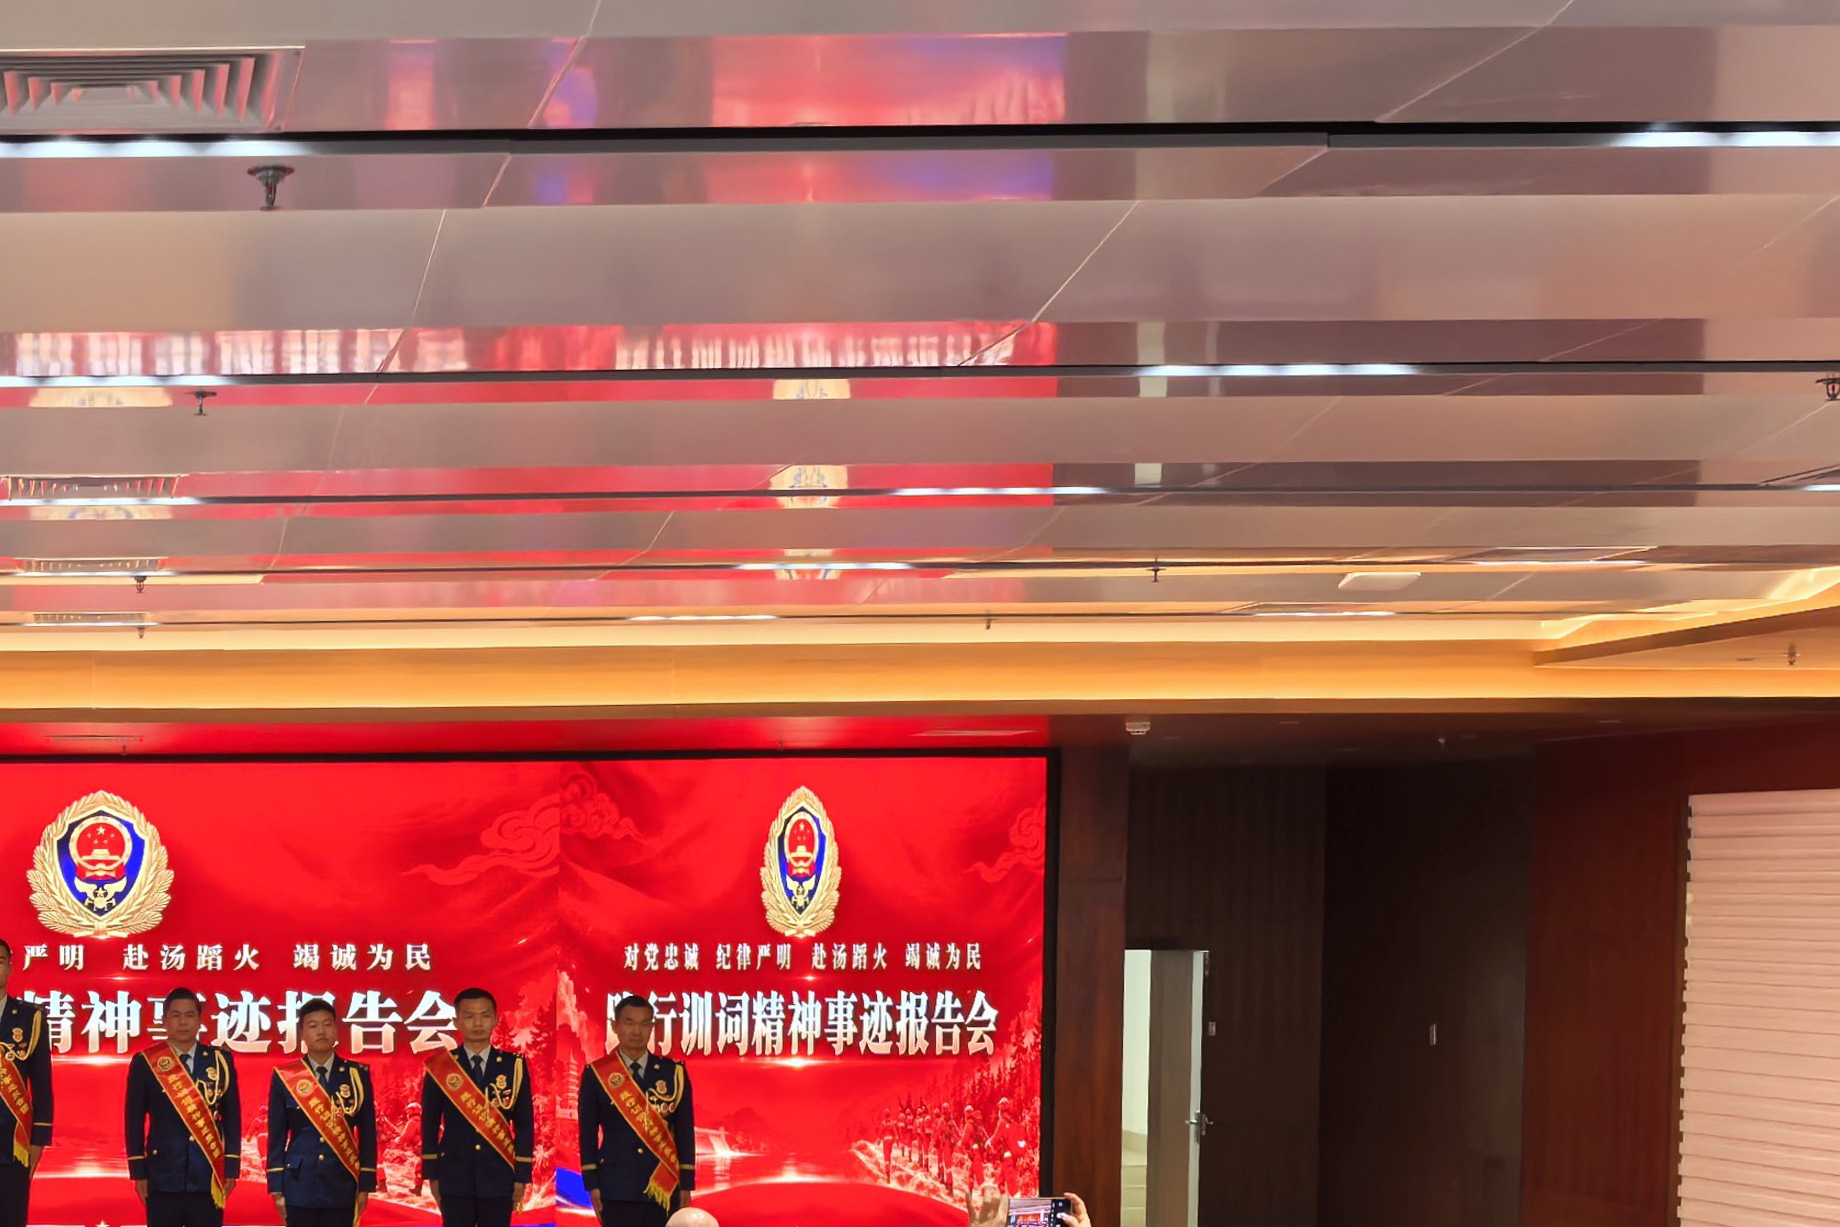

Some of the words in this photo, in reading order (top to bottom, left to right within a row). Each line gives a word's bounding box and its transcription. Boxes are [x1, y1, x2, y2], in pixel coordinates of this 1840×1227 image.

[123, 943, 260, 971] 赴汤蹈火
[293, 943, 431, 971] 竭诚为民
[624, 942, 699, 971] 对党忠诚
[716, 942, 791, 971] 纪律严明
[811, 942, 887, 971] 赴汤蹈火
[905, 942, 981, 971] 竭诚为民
